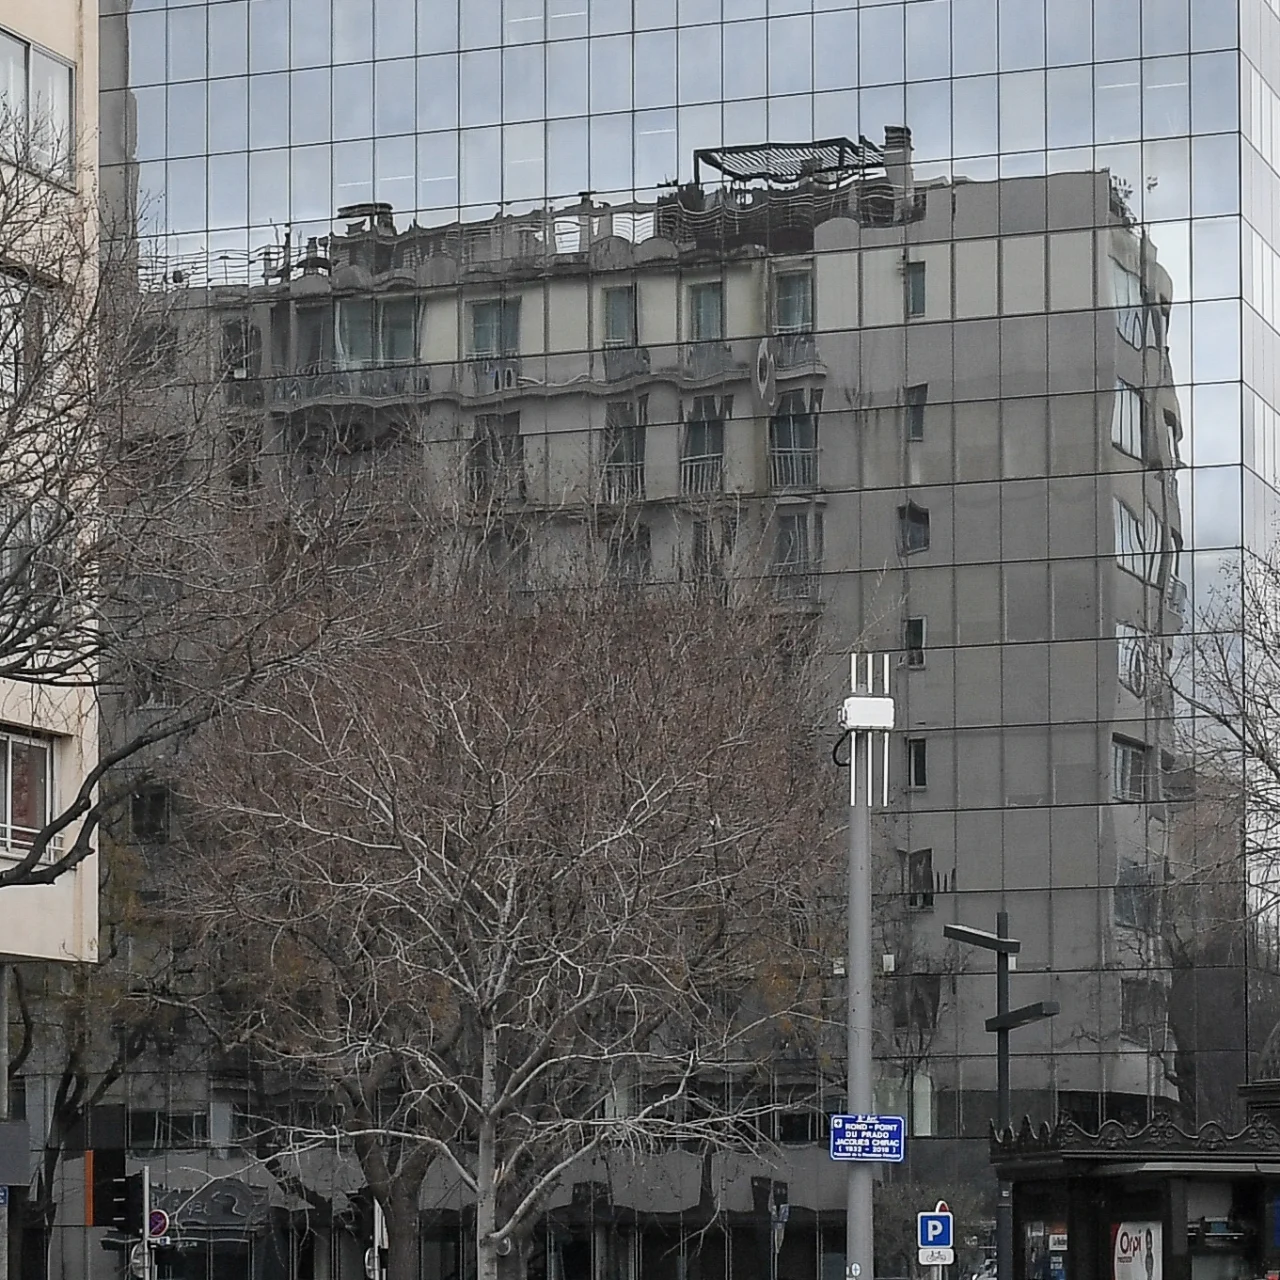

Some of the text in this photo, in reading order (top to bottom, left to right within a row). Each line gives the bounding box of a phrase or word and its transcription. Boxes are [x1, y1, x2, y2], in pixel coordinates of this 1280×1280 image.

[871, 1139, 899, 1147] CHIRAC
[927, 1220, 943, 1241] P
[1120, 1230, 1141, 1257] Orpi
